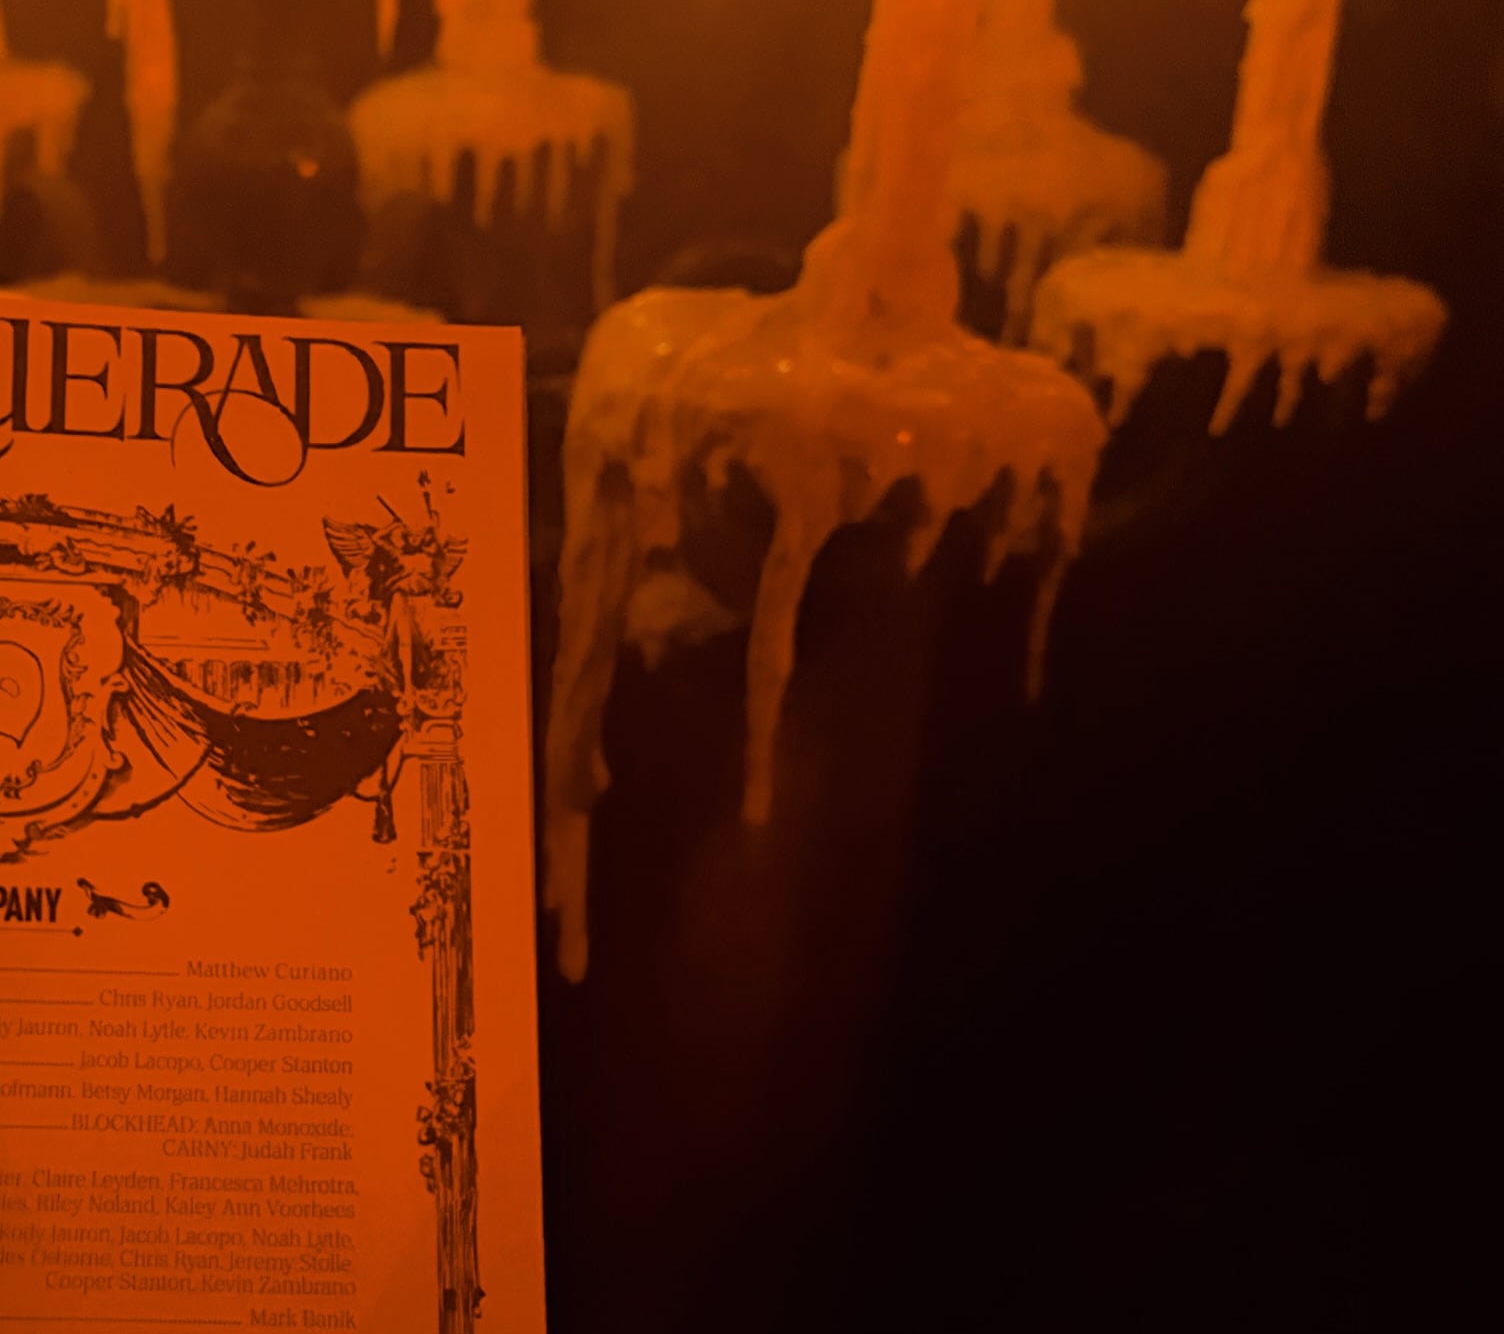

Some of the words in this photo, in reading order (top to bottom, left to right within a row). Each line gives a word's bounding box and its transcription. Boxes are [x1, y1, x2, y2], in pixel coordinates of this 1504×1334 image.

[187, 961, 267, 979] Matthew
[99, 989, 146, 1007] Chris
[153, 992, 202, 1013] Ryan,
[207, 992, 266, 1010] Jordan
[272, 995, 352, 1014] Goodsell
[90, 1019, 136, 1037] Noah
[143, 1020, 188, 1043] Lytle,
[195, 1022, 248, 1042] Kevin
[254, 1024, 352, 1043] Zambrano
[79, 1050, 128, 1070] Jacob
[210, 1053, 275, 1076] Cooper
[281, 1055, 352, 1074] Stanton
[82, 1081, 130, 1103] Betsy
[136, 1083, 209, 1105] Morgan,
[215, 1085, 286, 1104] Hannah
[292, 1087, 352, 1108] Shealy
[204, 1116, 251, 1135] Anna
[241, 1140, 295, 1159] Judah
[300, 1142, 352, 1161] Frank
[32, 1168, 86, 1188] Claire
[170, 1172, 263, 1192] Francesca
[269, 1174, 359, 1195] Mehrotra,
[37, 1194, 83, 1217] Riley
[165, 1197, 216, 1218] Kaley
[222, 1198, 261, 1217] Ann
[266, 1199, 355, 1218] Voorhees
[119, 1224, 169, 1245] Jacob
[252, 1228, 300, 1247] Noah
[119, 1250, 169, 1268] Chris
[228, 1252, 292, 1275] Jeremy
[46, 1271, 113, 1295] Cooper
[202, 1275, 253, 1294] Kevin
[258, 1276, 356, 1296] Zambrano
[250, 1308, 297, 1328] Mark
